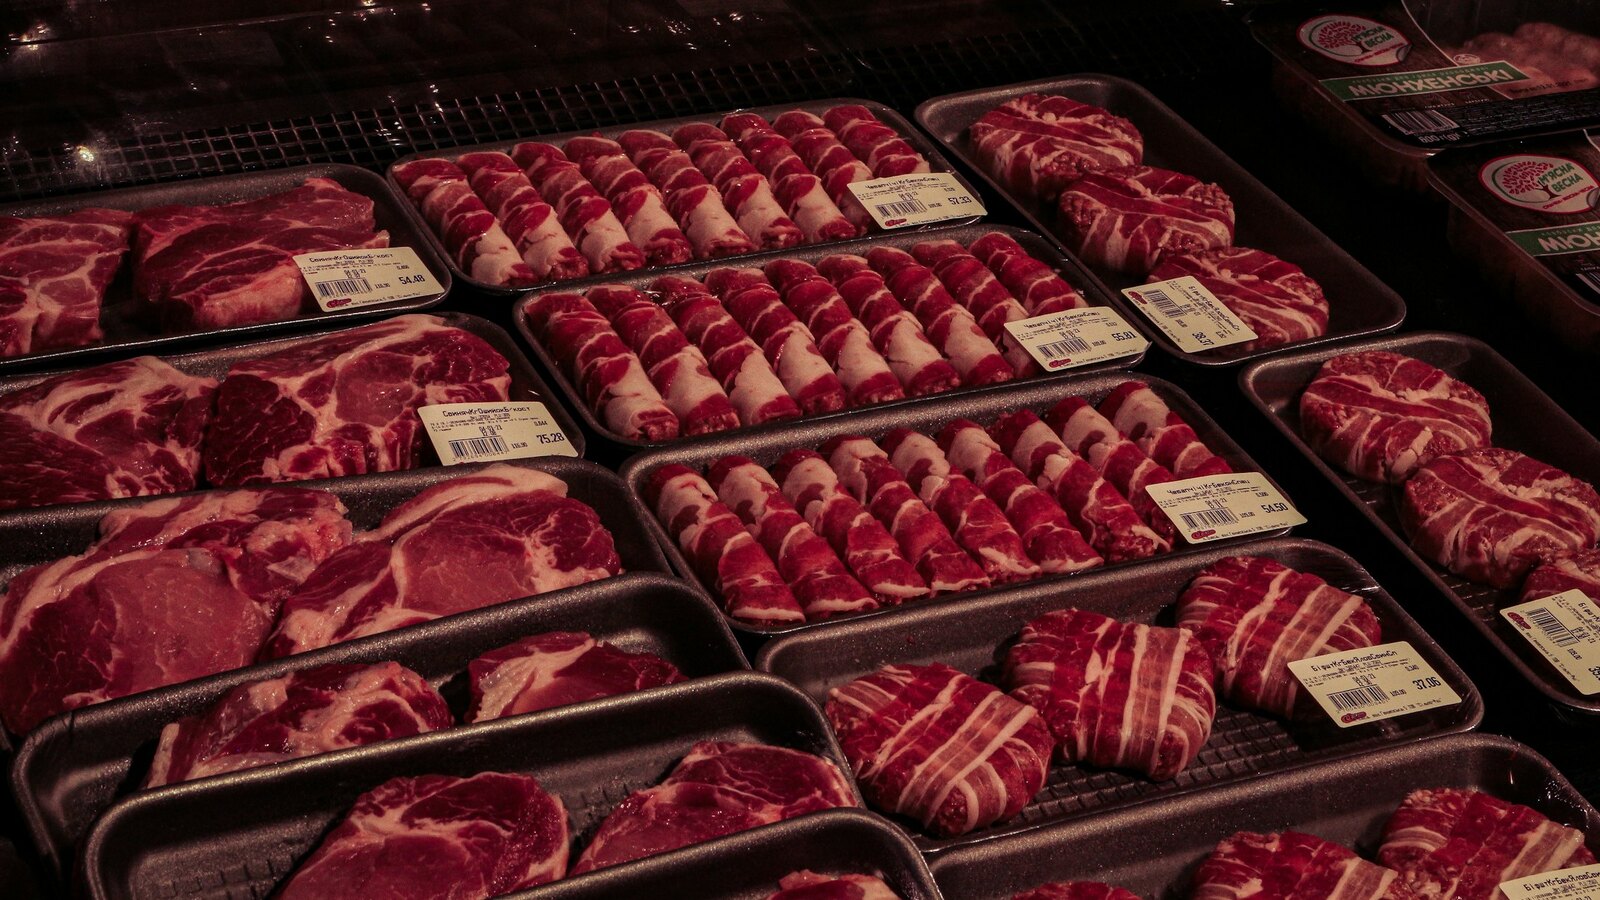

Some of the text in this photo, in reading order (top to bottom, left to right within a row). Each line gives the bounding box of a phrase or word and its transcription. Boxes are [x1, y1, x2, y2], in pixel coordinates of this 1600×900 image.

[1348, 69, 1515, 97] МЮНХЕНСЬКІ
[1537, 162, 1575, 185] М'ЯСНА
[1551, 173, 1583, 193] ВЕСНА
[948, 195, 973, 205] 57.33
[398, 274, 426, 285] 54.48
[1111, 330, 1138, 342] 55.81
[536, 432, 565, 445] 75.28
[1260, 502, 1289, 514] 54.50
[1412, 676, 1442, 691] 37.06
